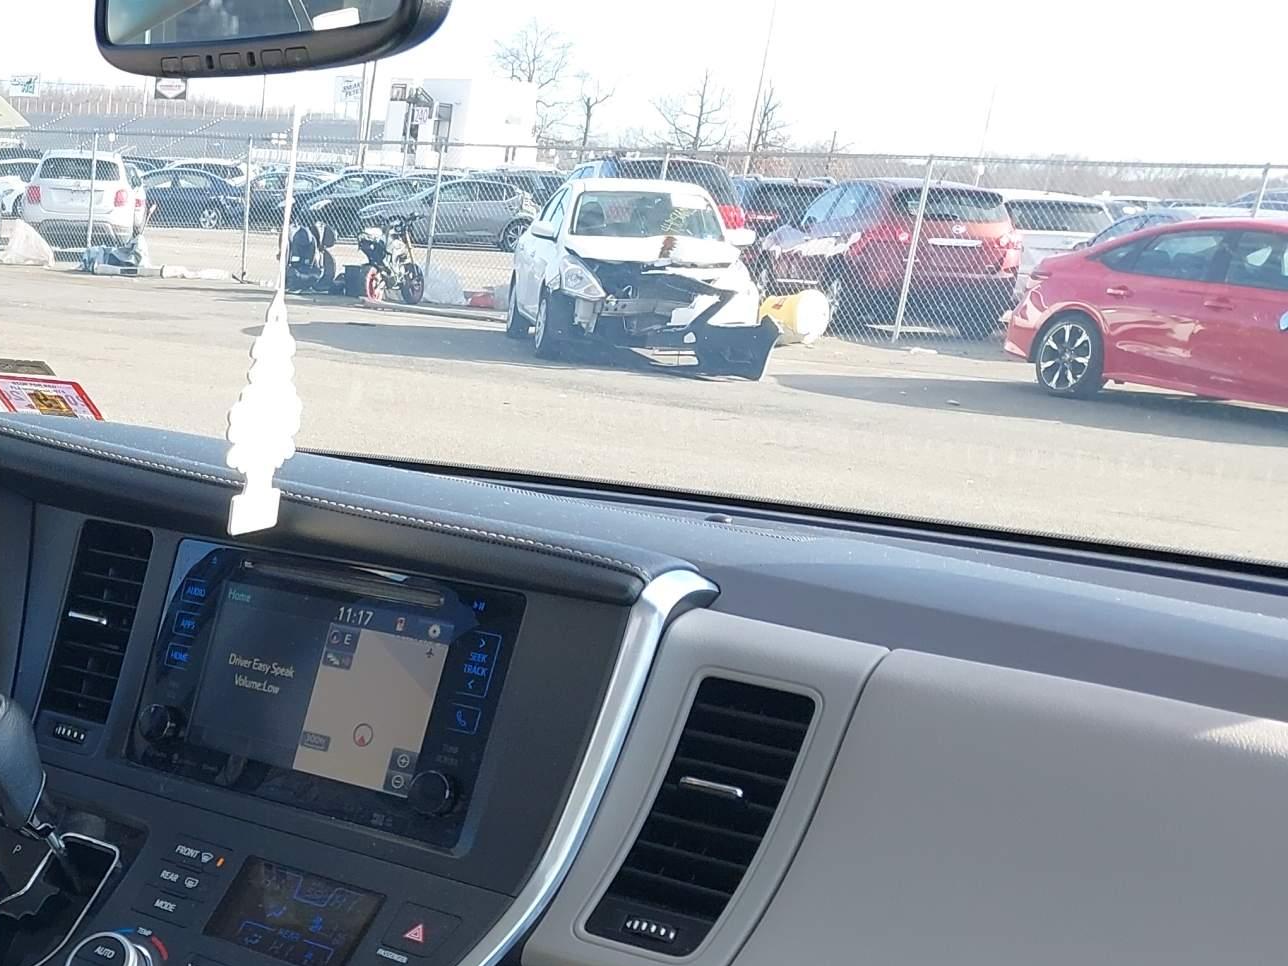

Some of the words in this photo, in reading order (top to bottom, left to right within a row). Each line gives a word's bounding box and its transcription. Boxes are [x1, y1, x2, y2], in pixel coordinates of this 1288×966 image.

[186, 585, 205, 597] AUDIO
[228, 588, 251, 602] Home
[339, 606, 374, 626] 11:17
[344, 633, 352, 645] E
[228, 653, 253, 669] Driver
[252, 658, 270, 675] Easy
[270, 662, 295, 679] Speak
[464, 663, 488, 677] TRACK
[12, 844, 22, 854] P
[176, 845, 200, 858] FRONT
[160, 870, 179, 882] REAR
[154, 899, 176, 912] MODE
[137, 927, 152, 937] TEMP
[94, 945, 115, 959] AUTO
